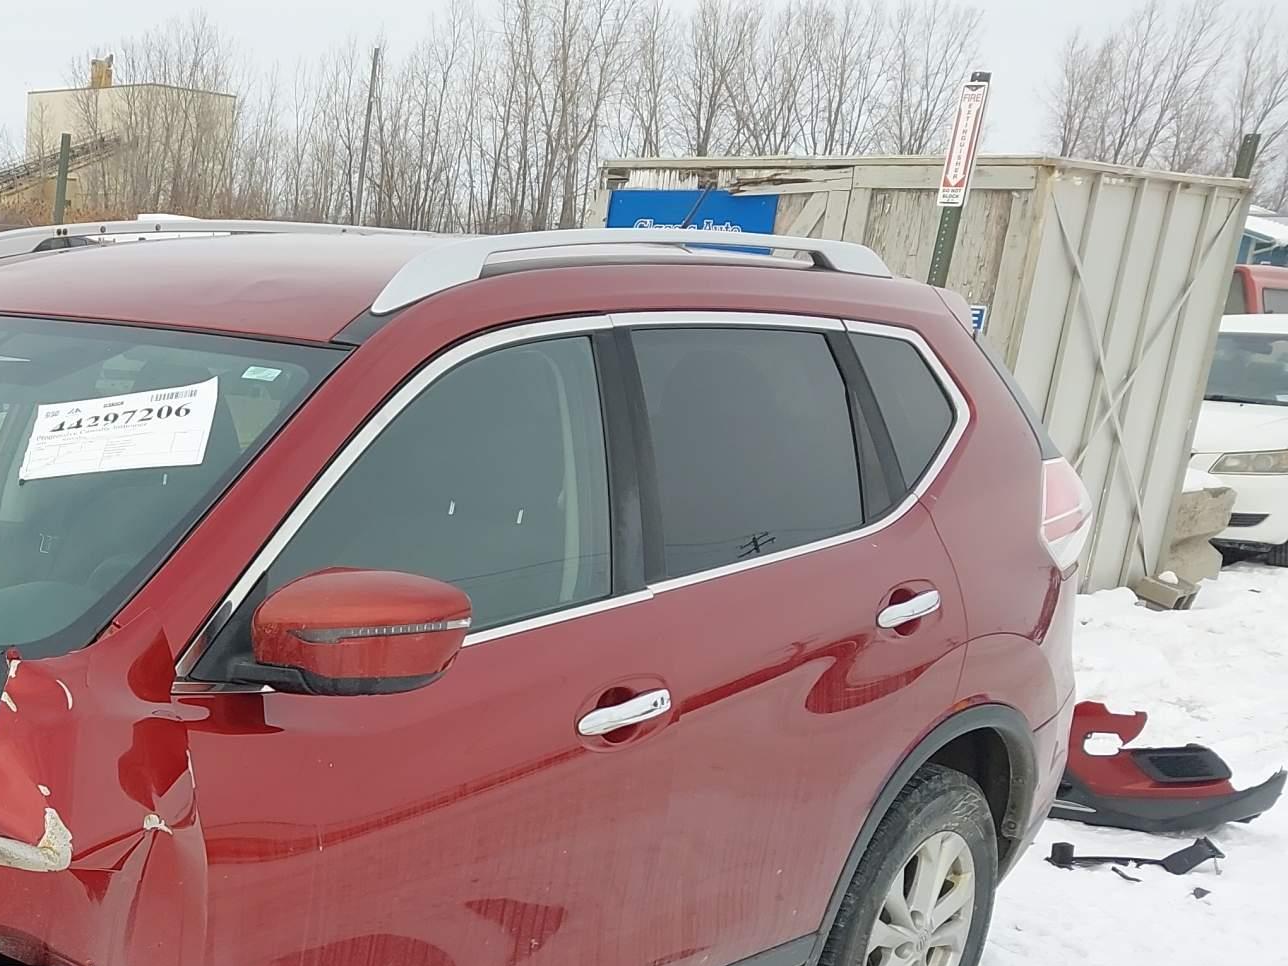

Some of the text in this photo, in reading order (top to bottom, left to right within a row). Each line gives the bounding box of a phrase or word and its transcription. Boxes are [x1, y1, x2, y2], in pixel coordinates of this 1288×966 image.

[963, 93, 982, 103] FIRE
[952, 102, 973, 179] EXTINGUISHER
[49, 401, 192, 432] 44297206
